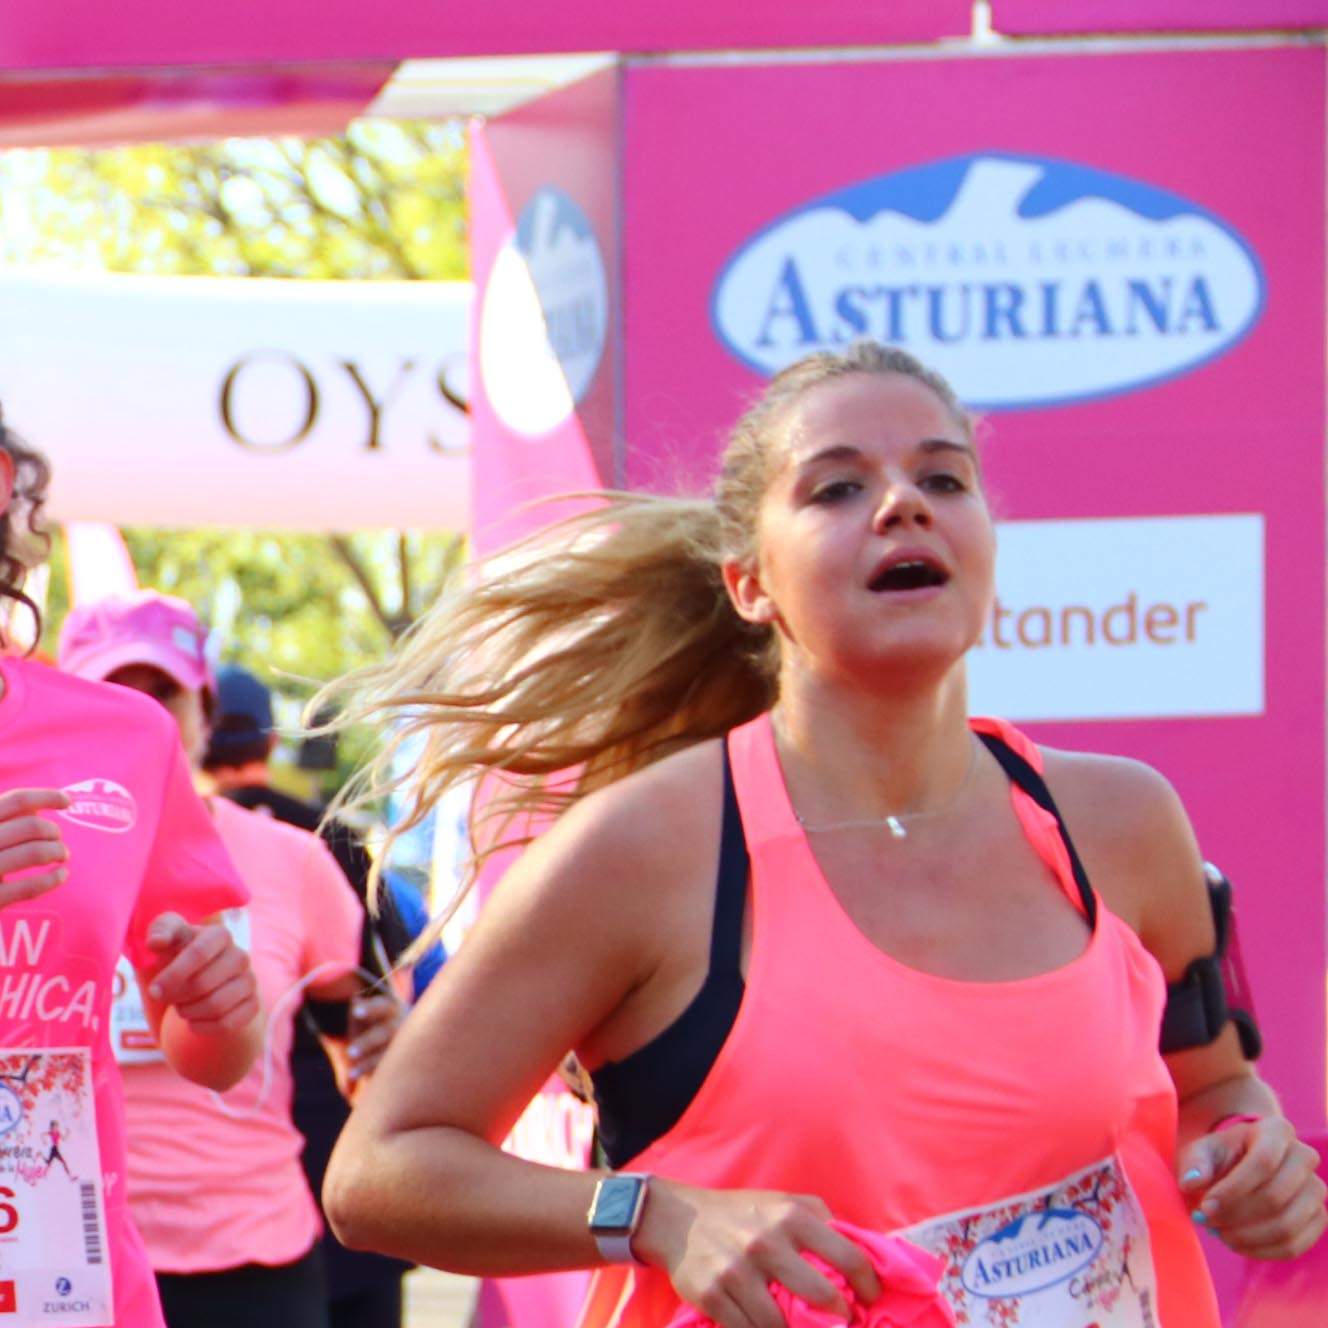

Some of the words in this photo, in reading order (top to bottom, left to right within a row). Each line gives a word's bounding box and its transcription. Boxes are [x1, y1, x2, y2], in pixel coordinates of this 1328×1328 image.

[834, 241, 1008, 269] CENTRAL
[1029, 234, 1207, 263] LECHERA
[753, 253, 1224, 348] ASTURIANA
[974, 590, 1209, 649] tander
[973, 1231, 1093, 1288] ASTURIANA
[43, 1302, 91, 1314] ZURICH
